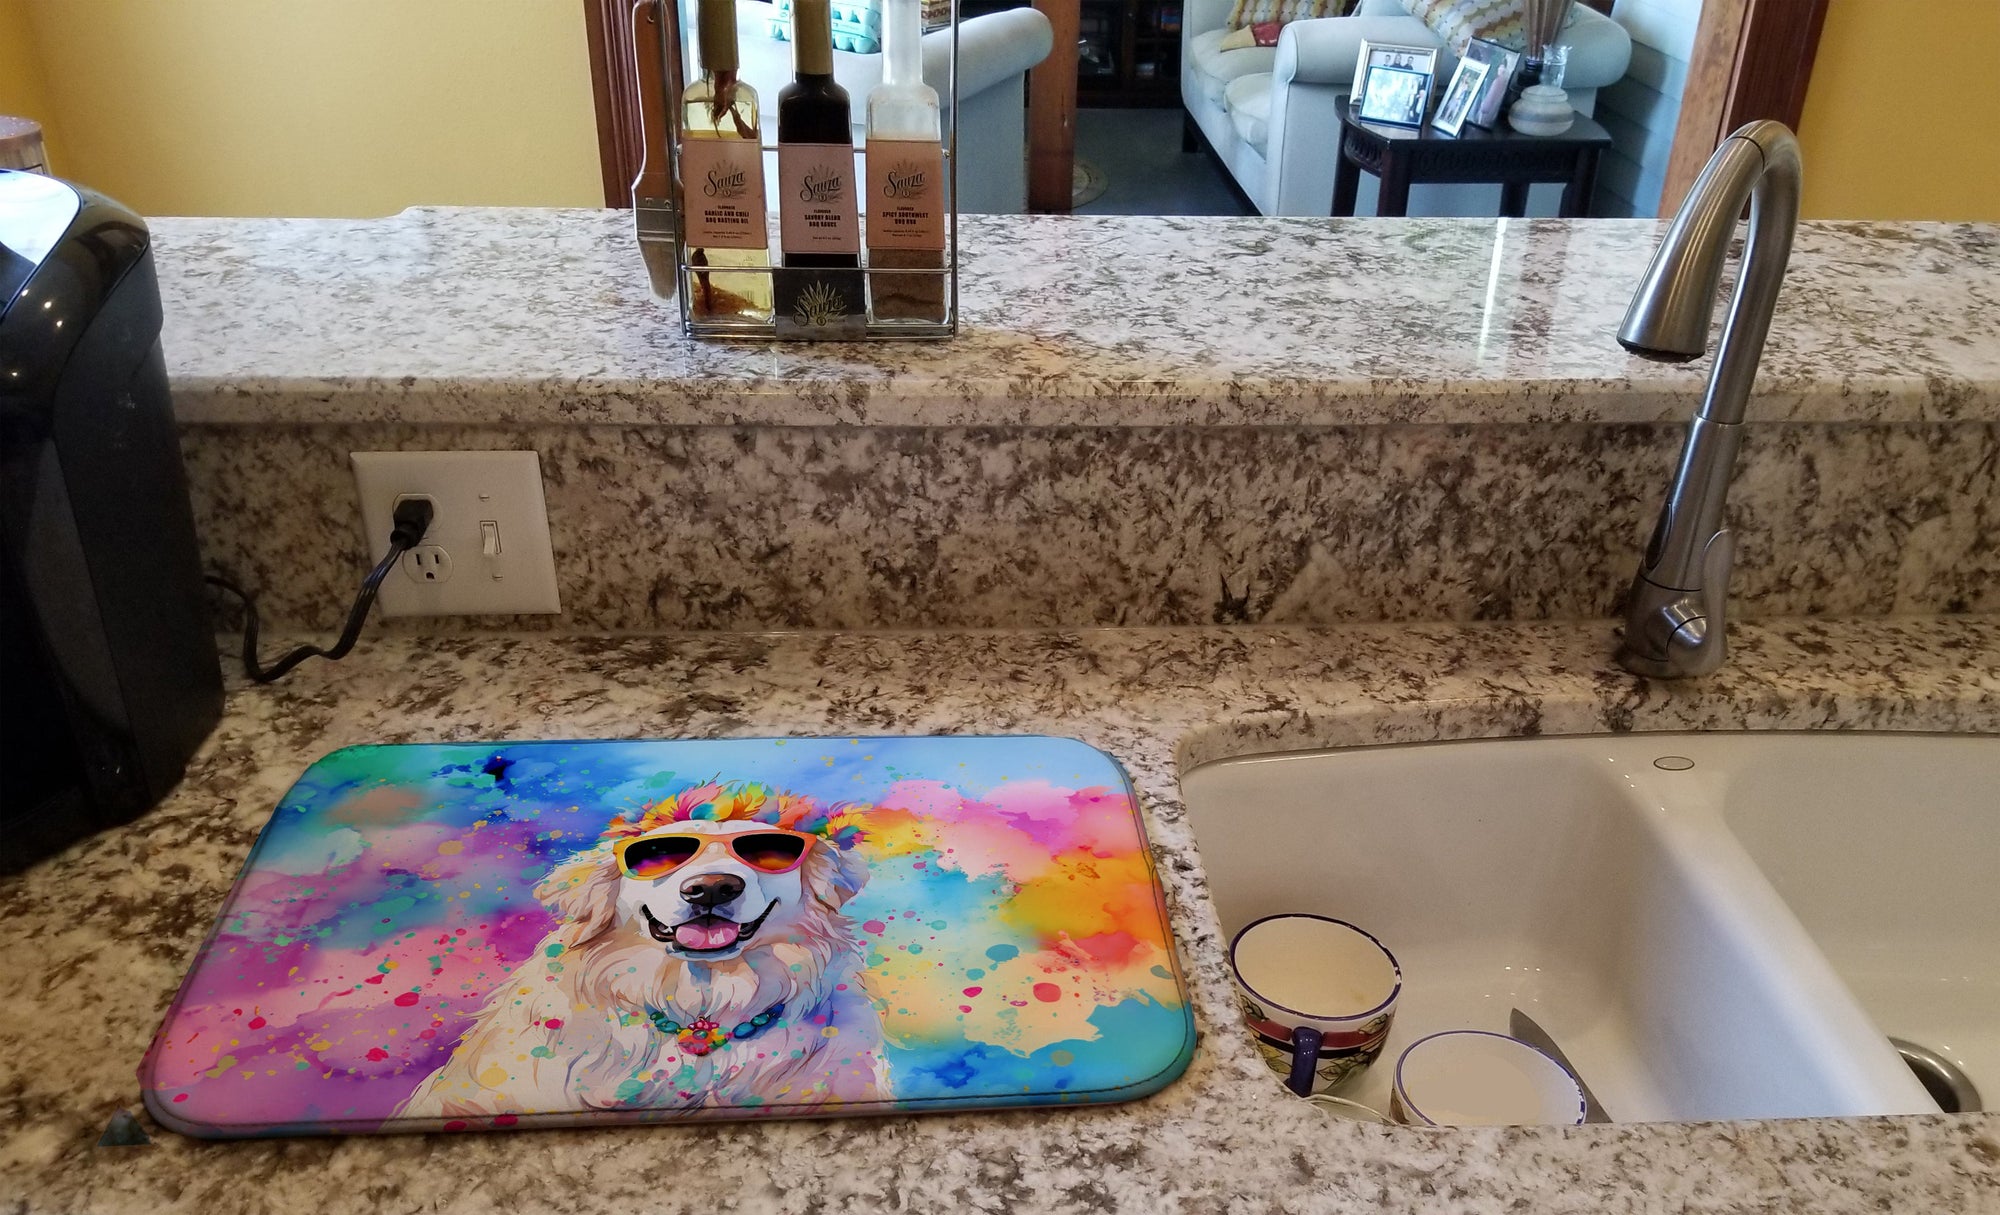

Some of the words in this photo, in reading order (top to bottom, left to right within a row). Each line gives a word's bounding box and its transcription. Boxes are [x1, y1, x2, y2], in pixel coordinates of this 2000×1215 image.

[704, 170, 745, 197] Sauza
[800, 175, 842, 202] Sauza
[883, 171, 925, 198] Sauza
[793, 295, 846, 327] Sauza
